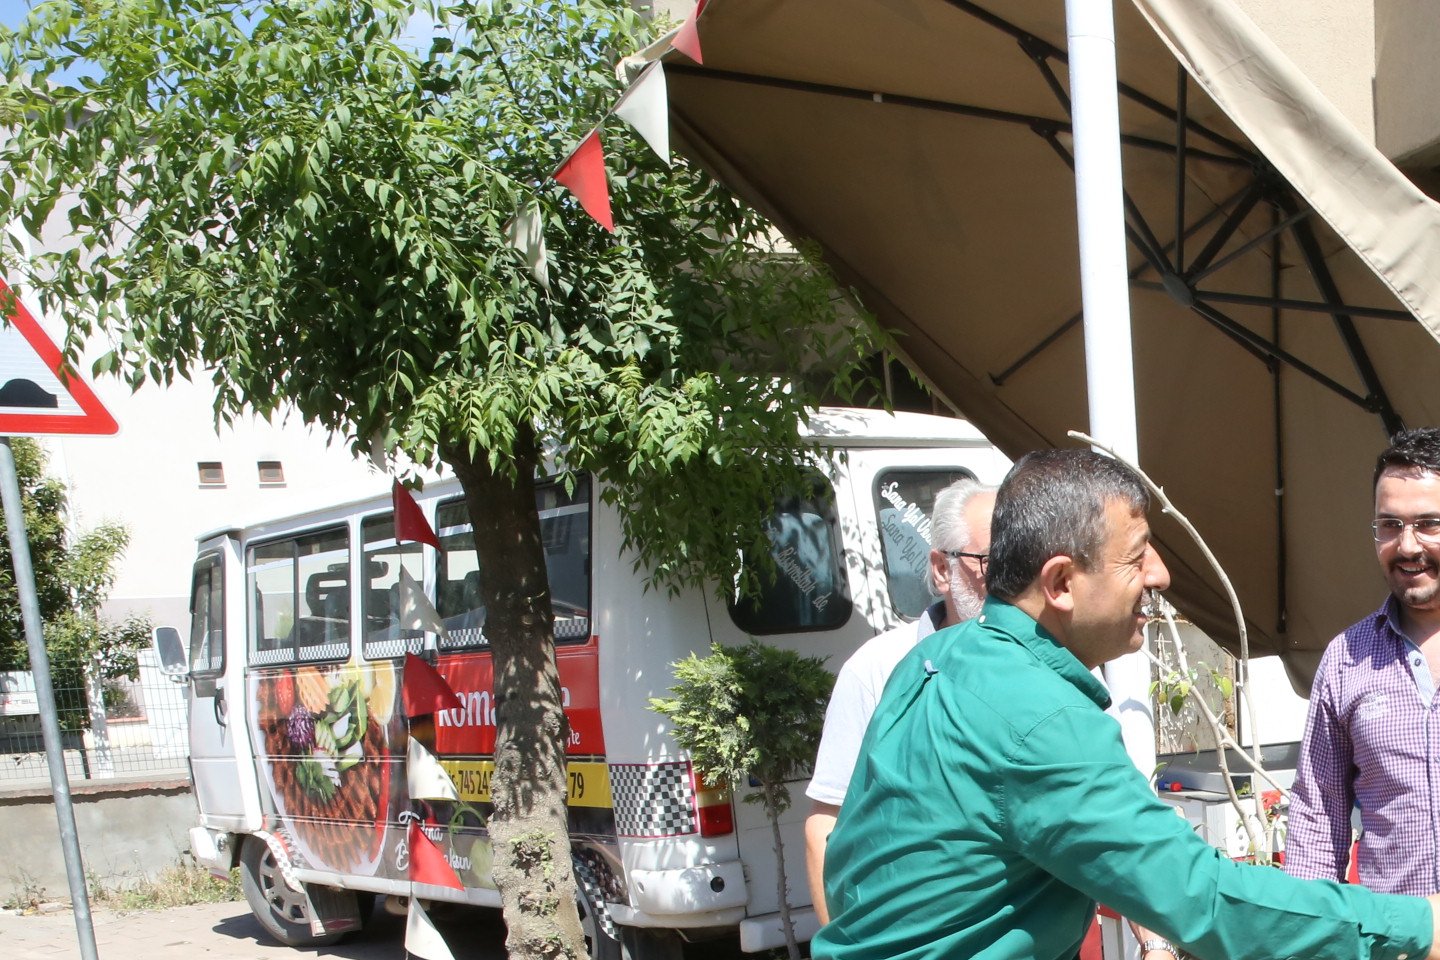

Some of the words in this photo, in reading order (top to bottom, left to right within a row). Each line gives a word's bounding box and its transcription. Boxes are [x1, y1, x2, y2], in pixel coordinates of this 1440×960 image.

[881, 481, 907, 512] Sana
[901, 502, 926, 529] Yol
[569, 772, 585, 798] 79
